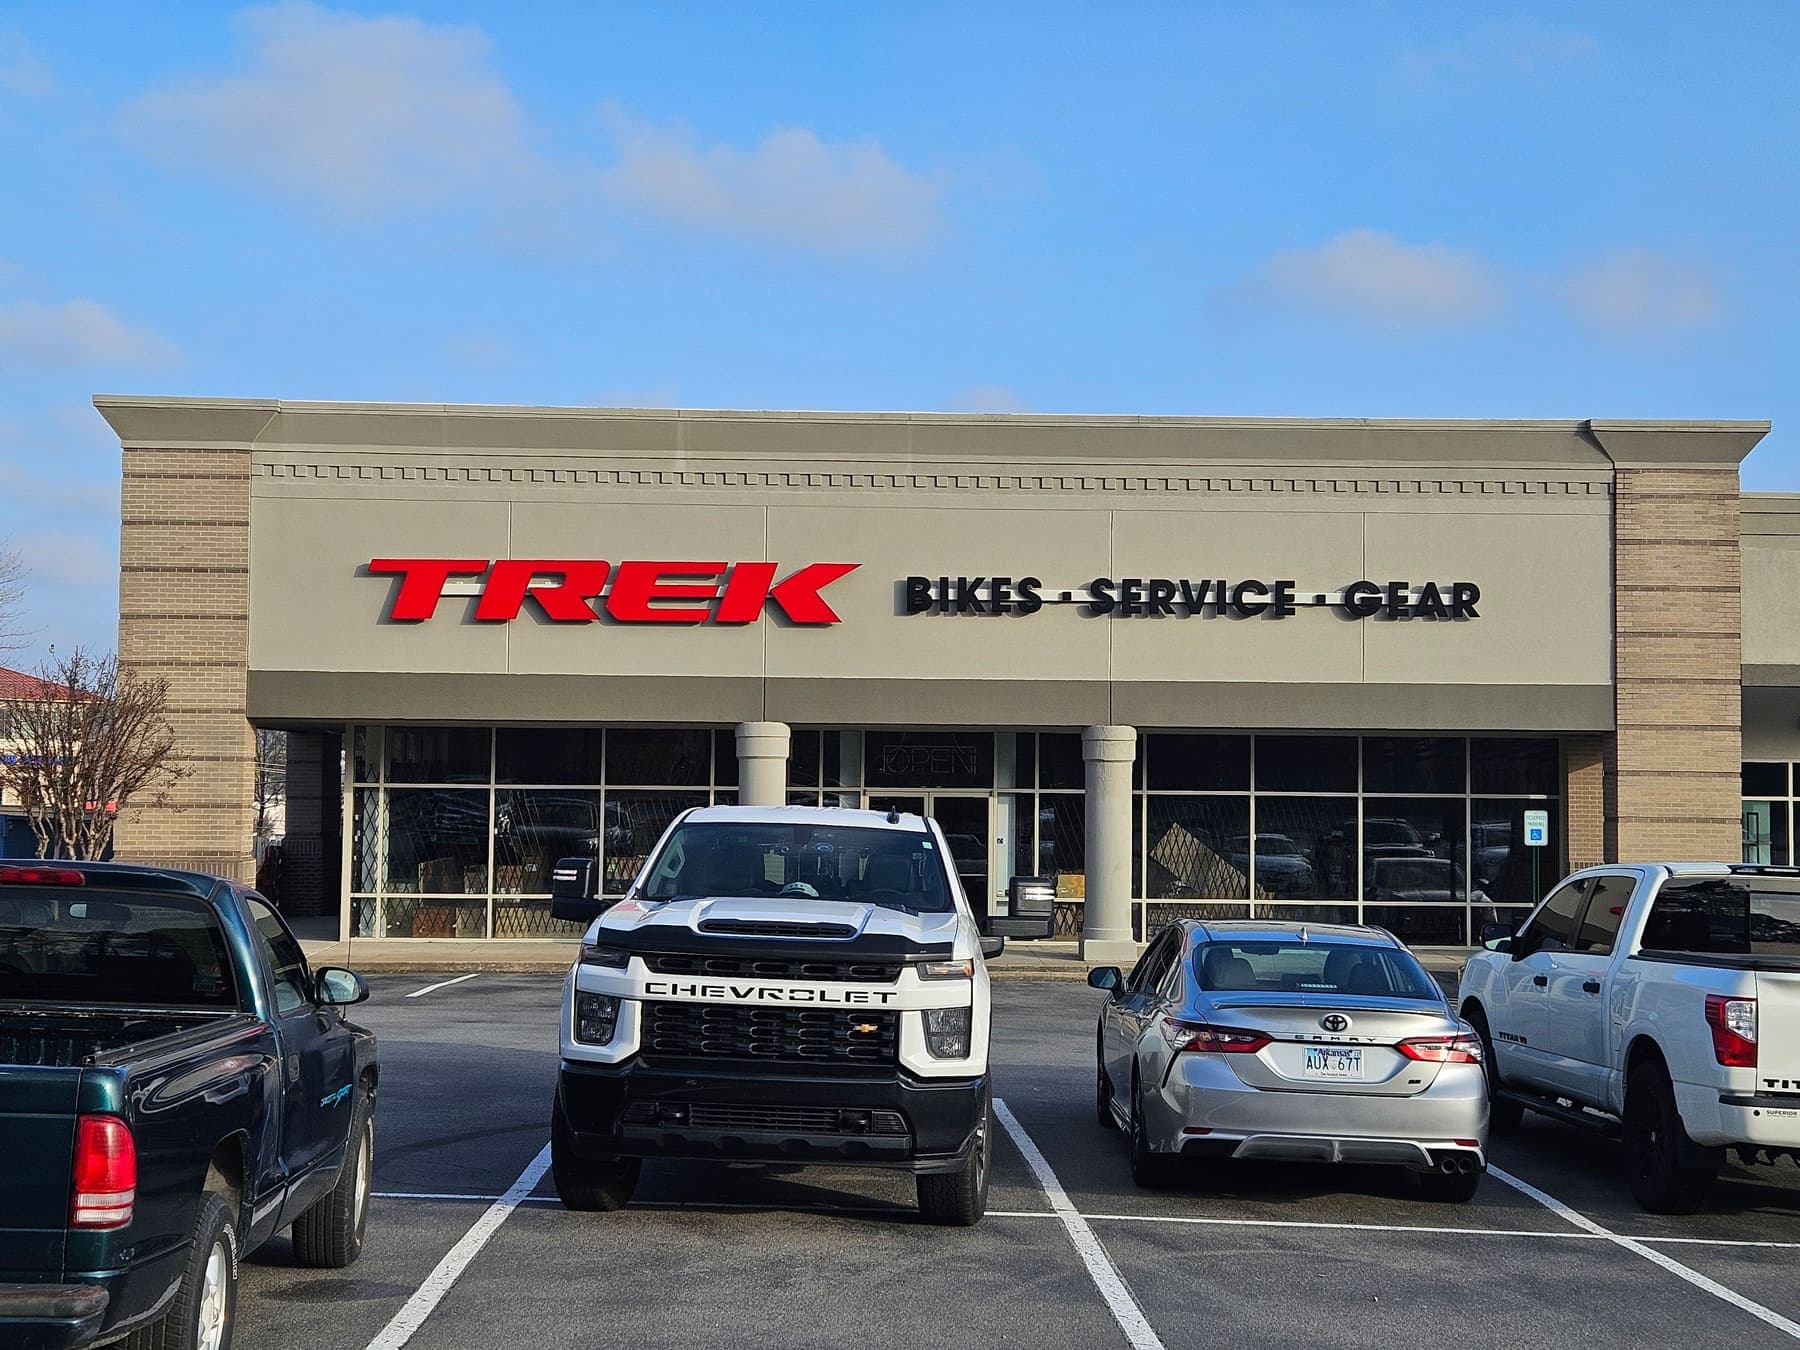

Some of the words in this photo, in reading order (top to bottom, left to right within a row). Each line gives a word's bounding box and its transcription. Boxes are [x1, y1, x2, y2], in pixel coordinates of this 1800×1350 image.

[368, 558, 863, 624] TREK
[906, 576, 1043, 614] BIKES
[1089, 579, 1296, 617] SERVICE
[1344, 581, 1481, 618] GEAR
[886, 747, 974, 774] OPEN
[645, 982, 898, 1004] CHEVROLET
[1306, 1056, 1329, 1070] AUX
[1337, 1057, 1360, 1072] 67T
